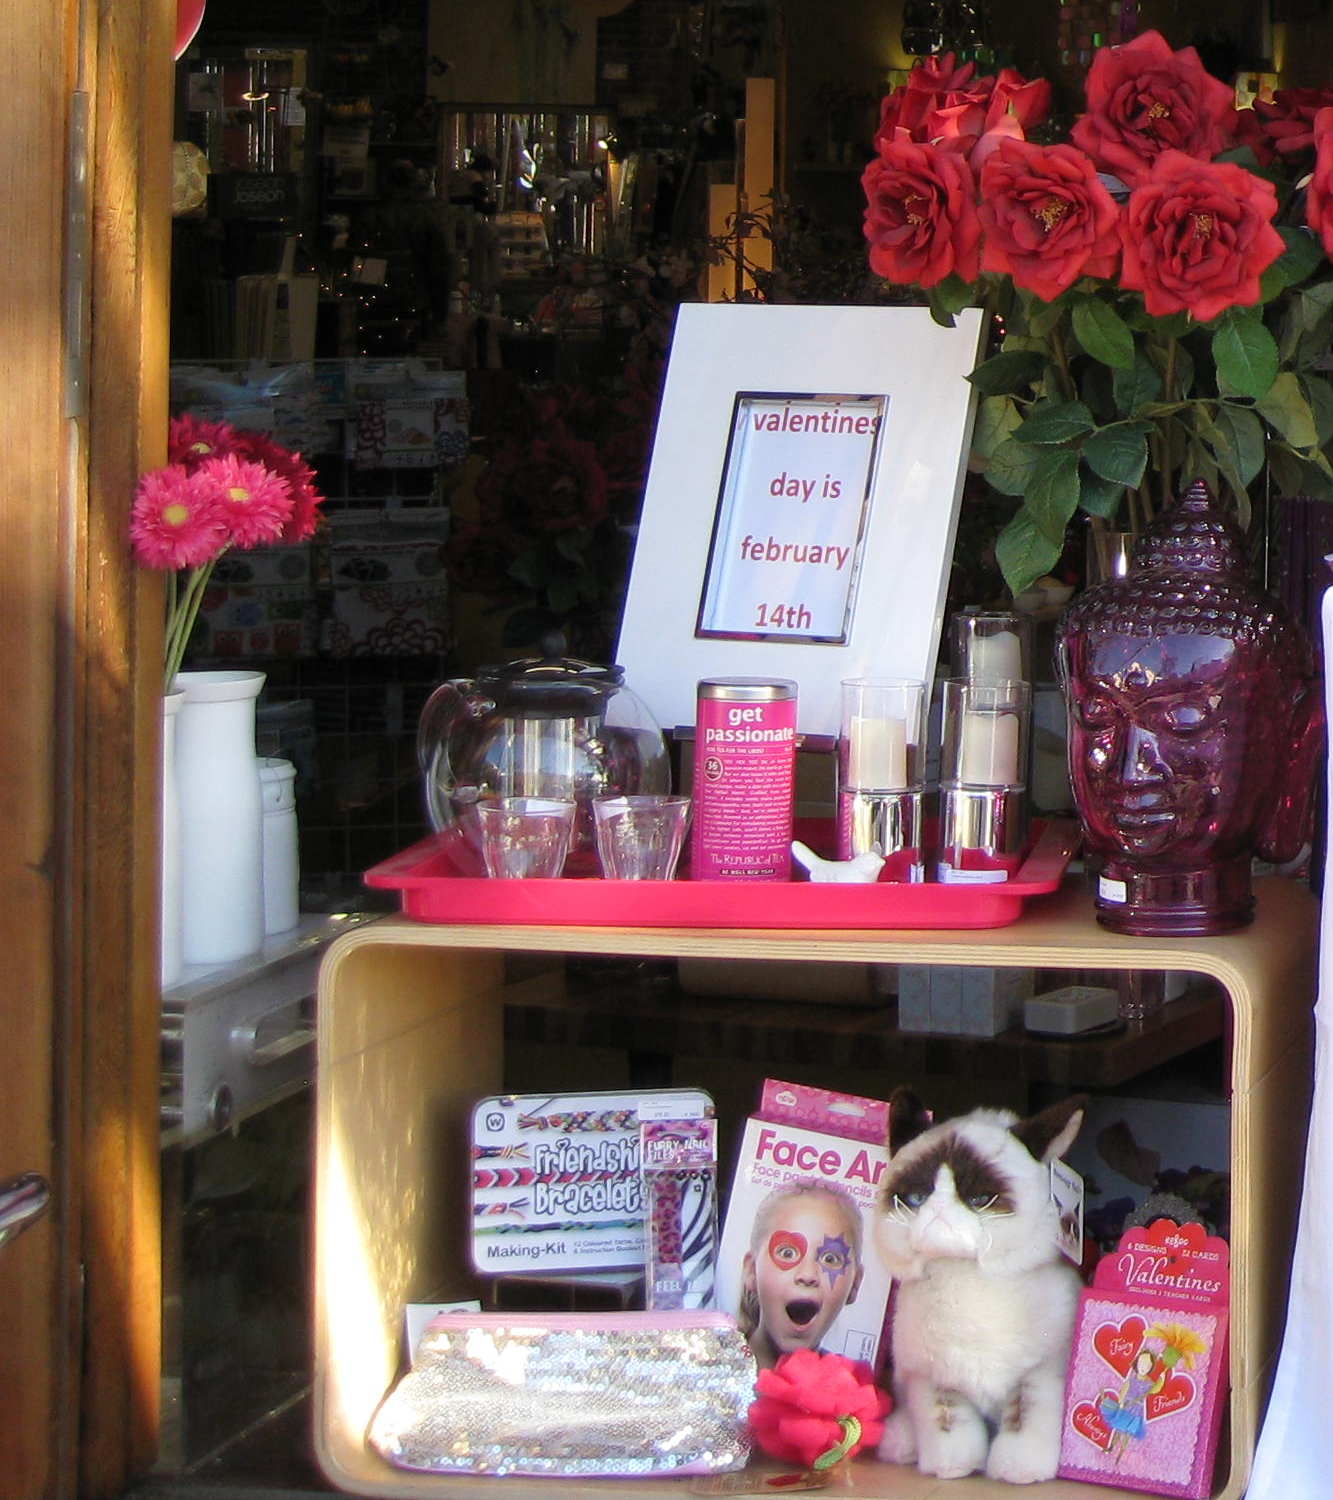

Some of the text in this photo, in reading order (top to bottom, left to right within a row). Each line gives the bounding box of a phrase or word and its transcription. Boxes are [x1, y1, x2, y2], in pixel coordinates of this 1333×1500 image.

[753, 407, 881, 435] valentines
[770, 472, 842, 503] day is
[741, 535, 851, 570] february
[755, 603, 813, 629] 14th
[728, 707, 763, 726] get
[706, 726, 794, 744] passionate
[647, 1141, 679, 1152] FURRY
[756, 1128, 842, 1176] Face
[753, 1162, 781, 1179] Face
[487, 1244, 567, 1258] Making-Kit
[1118, 1253, 1221, 1293] Valentines
